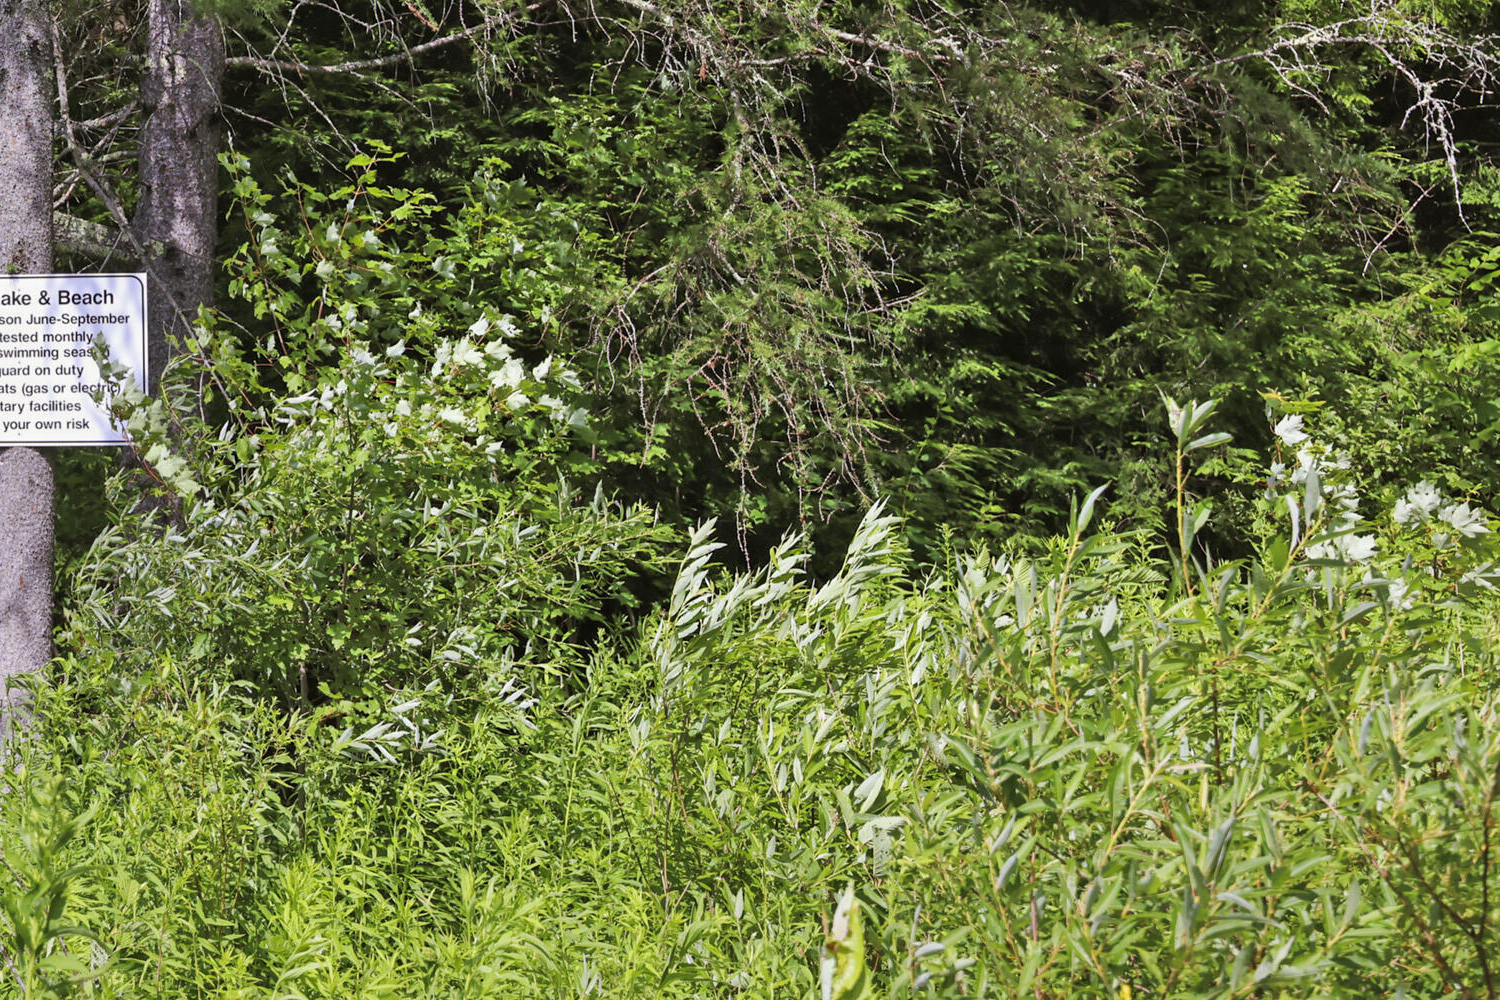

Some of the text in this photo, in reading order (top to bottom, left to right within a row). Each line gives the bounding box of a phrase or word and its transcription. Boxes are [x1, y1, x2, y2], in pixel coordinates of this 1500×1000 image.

[38, 289, 51, 306] &
[58, 289, 114, 306] Beach
[26, 312, 130, 328] June-September
[42, 330, 94, 345] monthly
[63, 347, 110, 359] seas
[34, 366, 51, 376] on
[55, 364, 84, 379] duty
[21, 383, 49, 397] (gas
[52, 384, 66, 394] or
[29, 400, 82, 412] facilities
[2, 420, 31, 433] your
[35, 420, 62, 430] own
[66, 418, 90, 430] risk
